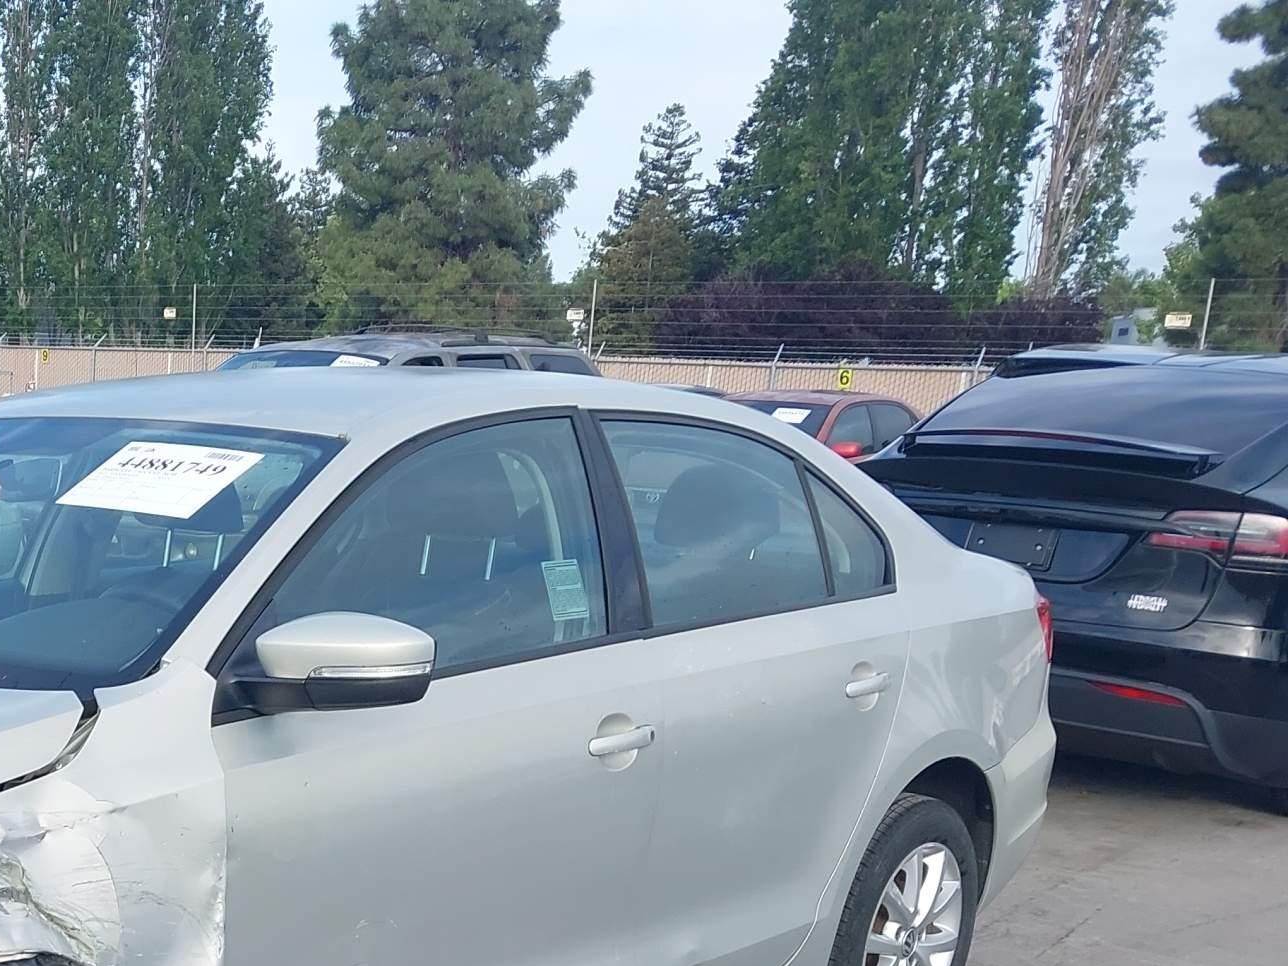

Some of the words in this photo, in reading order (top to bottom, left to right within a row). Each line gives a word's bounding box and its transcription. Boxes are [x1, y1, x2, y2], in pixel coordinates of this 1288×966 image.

[42, 350, 48, 361] 9
[839, 370, 850, 385] 6
[117, 455, 228, 477] 44881749
